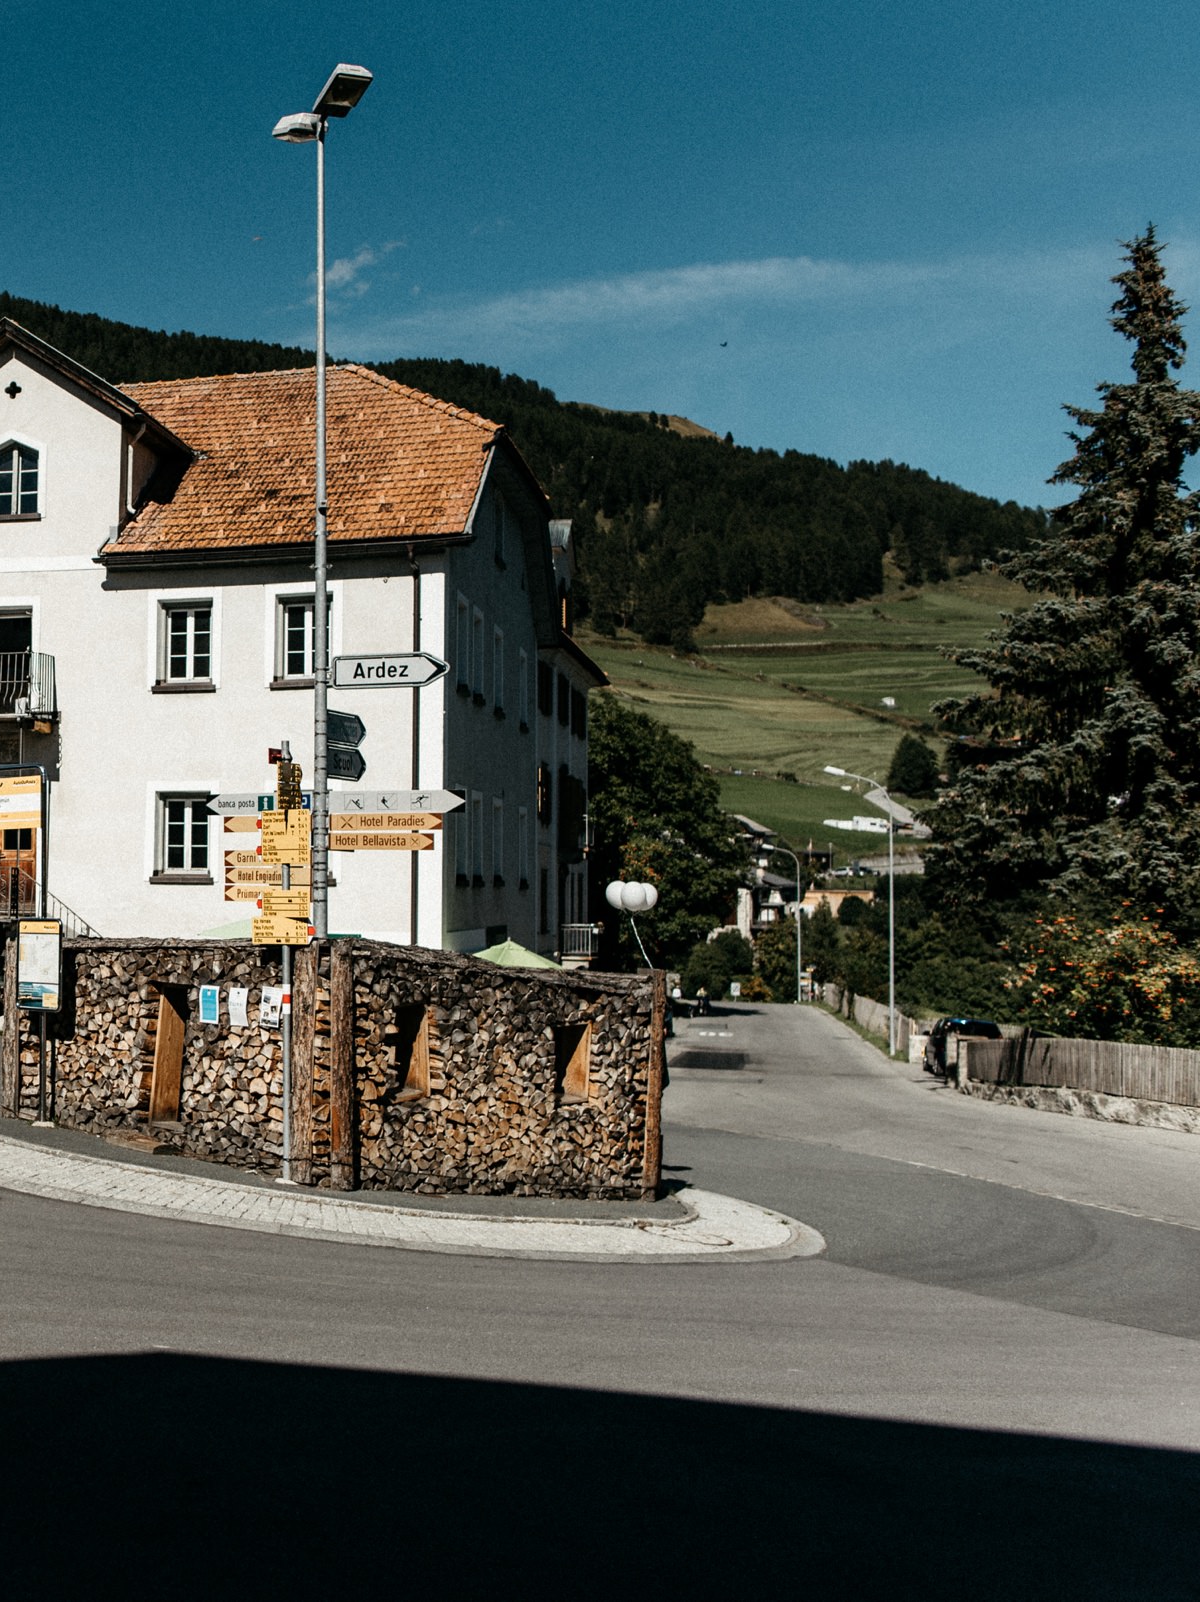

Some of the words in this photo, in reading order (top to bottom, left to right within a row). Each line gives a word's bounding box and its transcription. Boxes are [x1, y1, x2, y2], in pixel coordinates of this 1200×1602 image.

[353, 662, 409, 679] Ardez
[333, 753, 353, 772] Scuol
[217, 799, 236, 808] banca
[237, 799, 256, 810] posta
[359, 814, 384, 826] Hotel
[387, 813, 426, 826] Paradies
[335, 835, 359, 847] Hotel
[362, 834, 407, 847] Bellavista
[236, 852, 256, 863] Garni
[237, 870, 254, 881] Hotel
[255, 870, 282, 884] Engiadin
